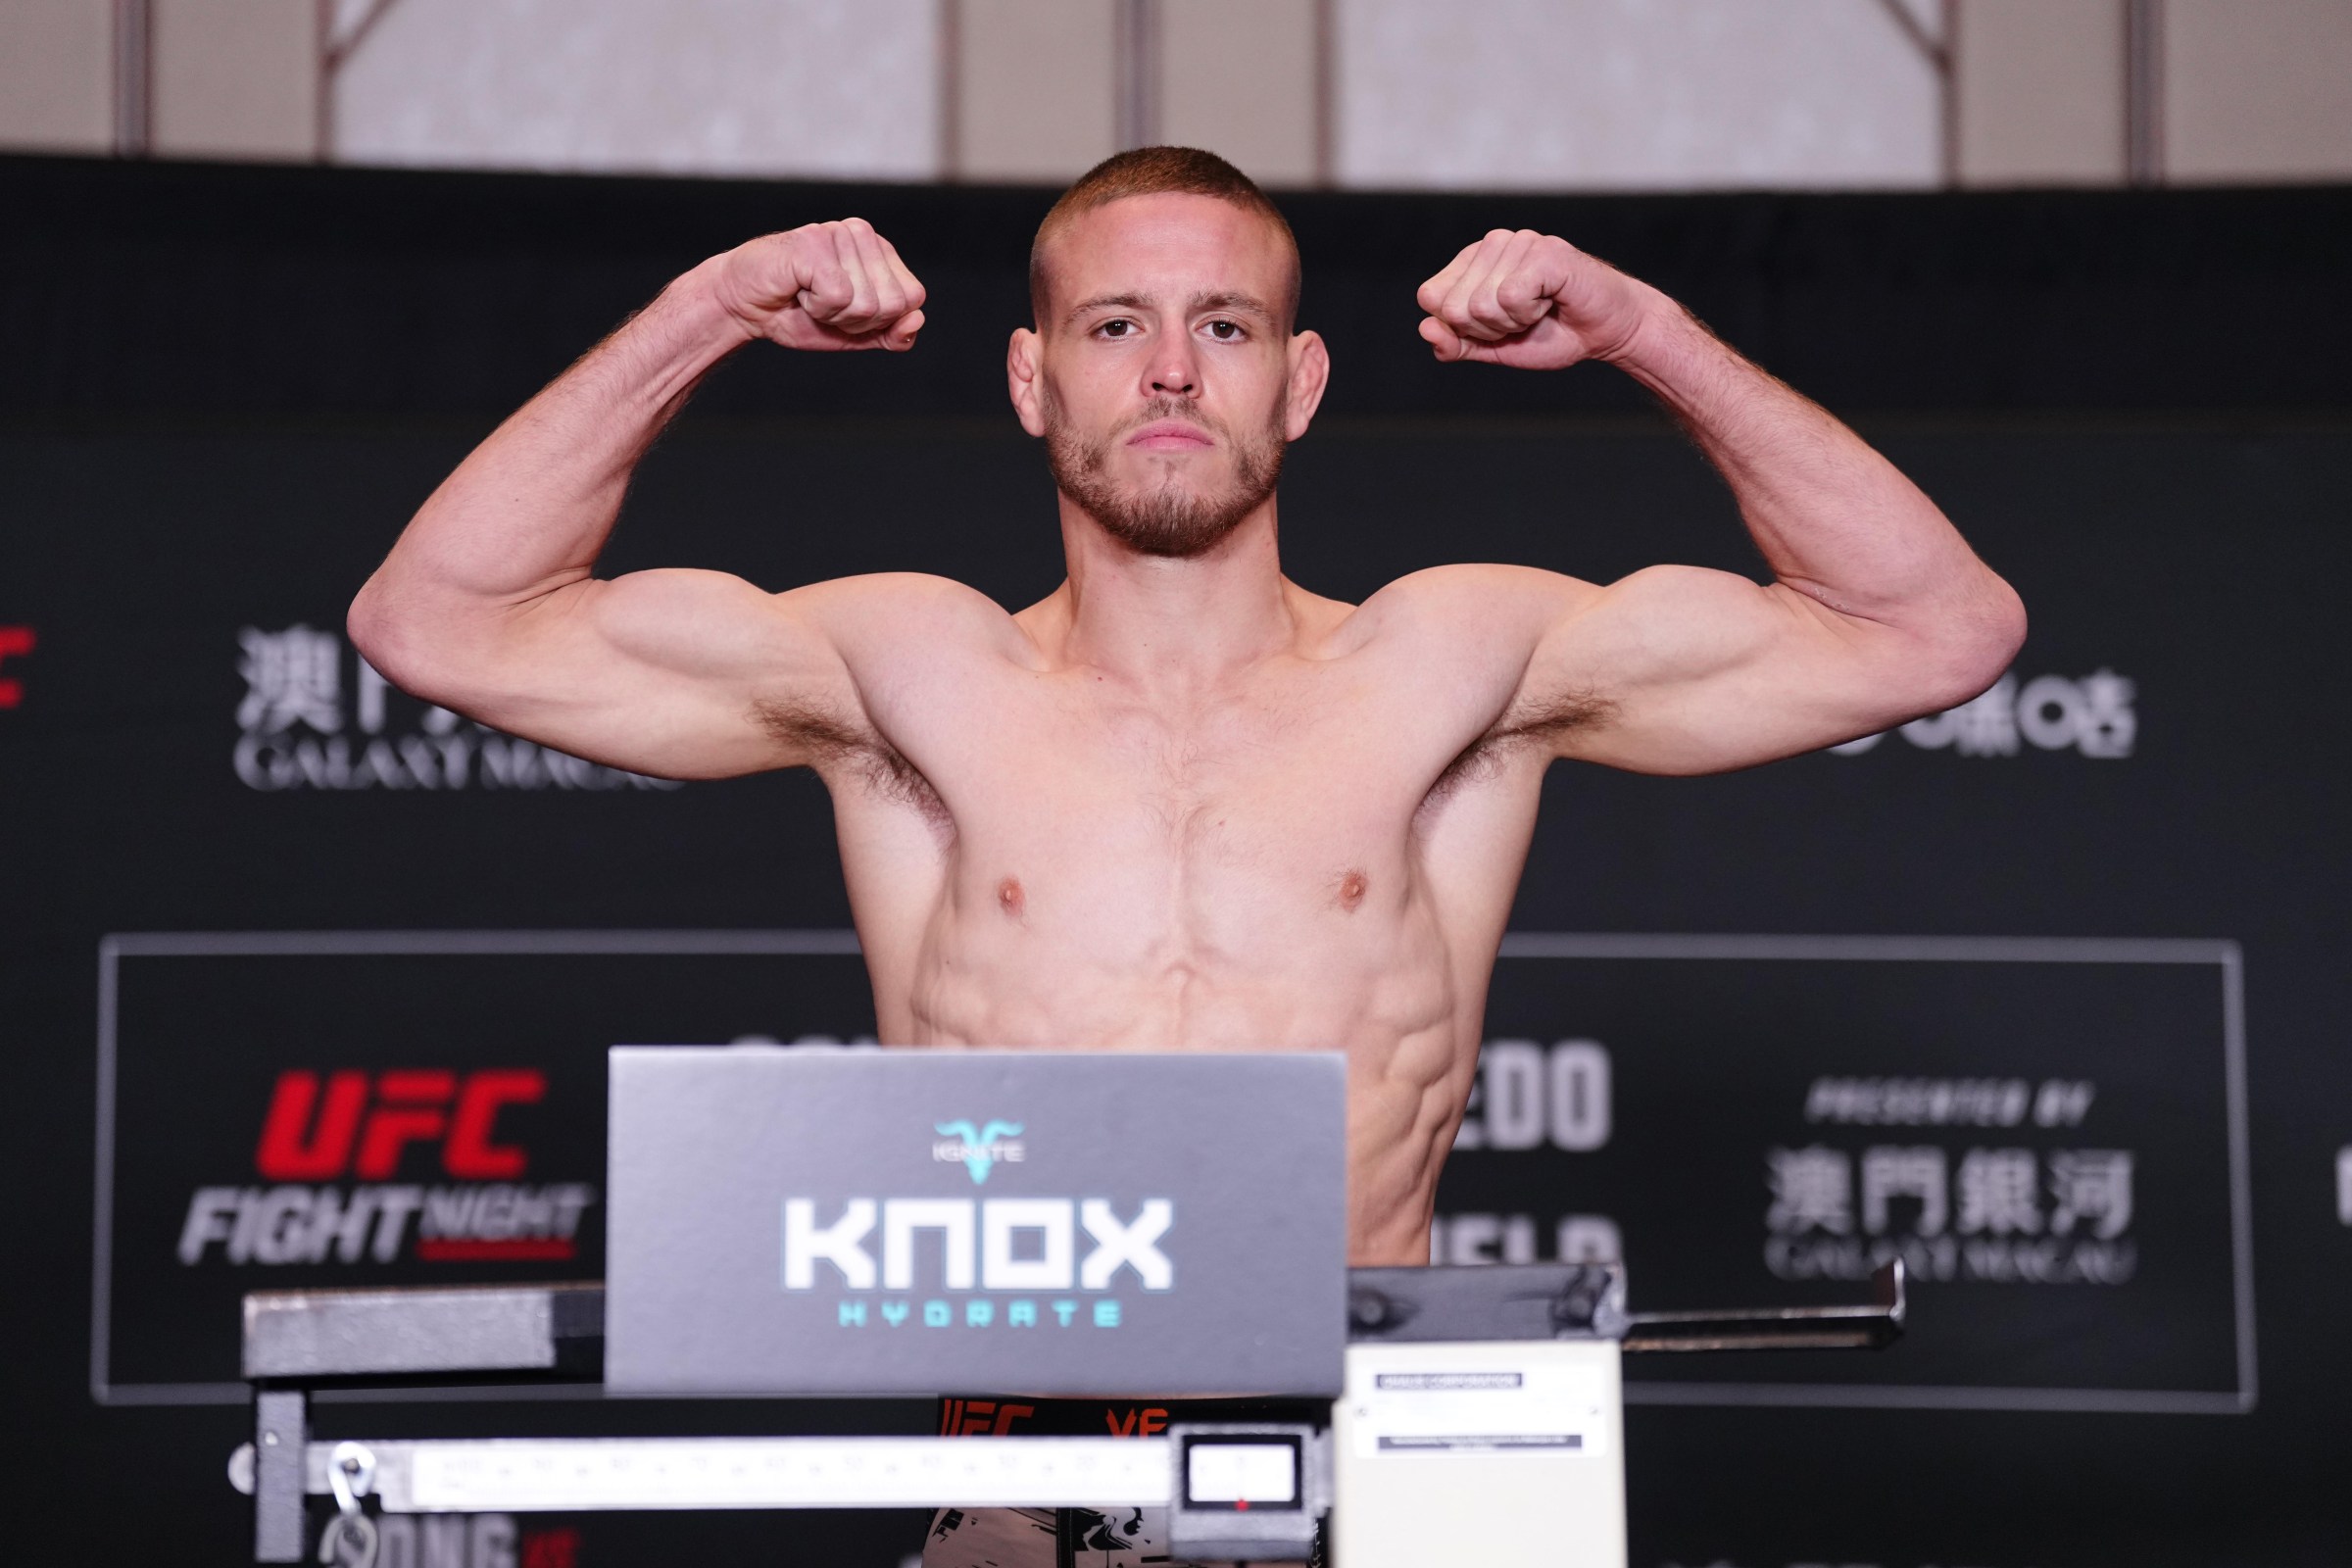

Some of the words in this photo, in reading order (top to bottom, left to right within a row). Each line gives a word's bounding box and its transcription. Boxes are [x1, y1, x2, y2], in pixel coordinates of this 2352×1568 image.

[256, 1068, 546, 1180] UFC
[176, 1183, 421, 1266] FIGHT
[418, 1183, 593, 1241] NIGHT
[782, 1198, 1175, 1292] KNOX
[839, 1301, 1123, 1329] HYDRATE
